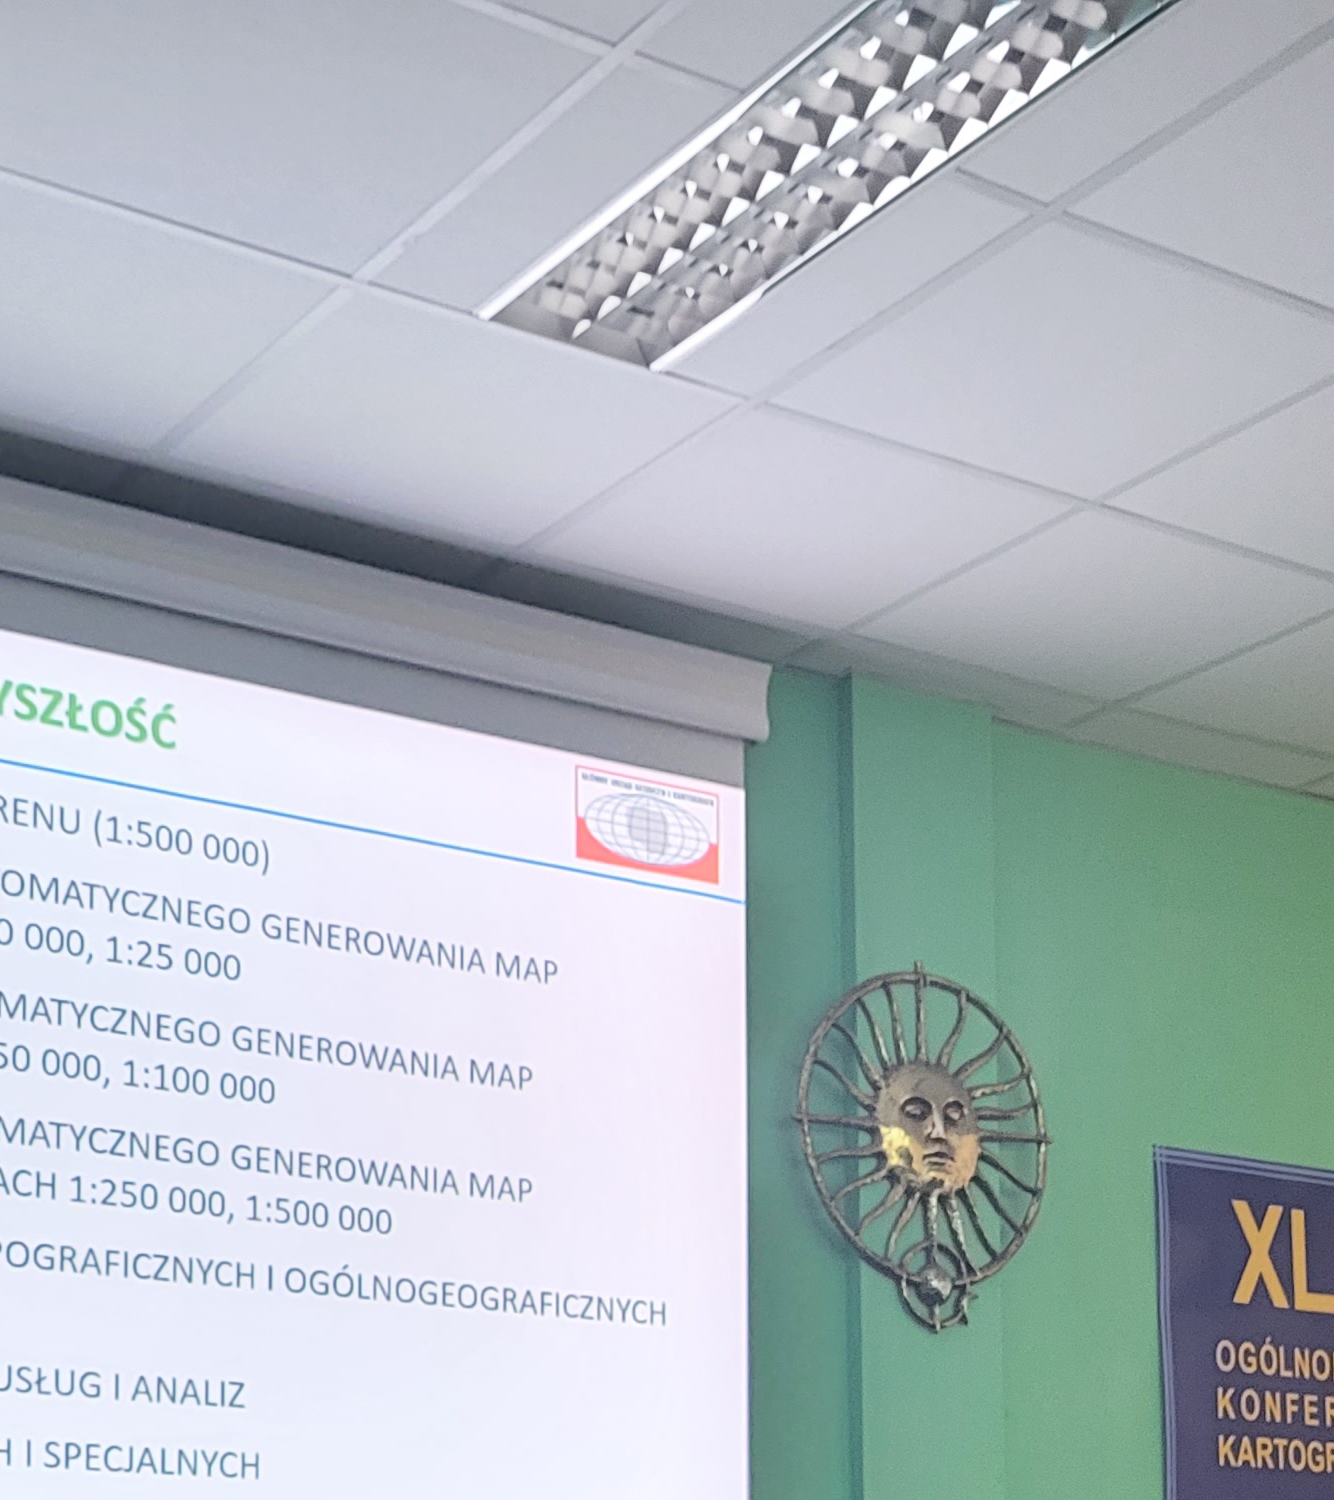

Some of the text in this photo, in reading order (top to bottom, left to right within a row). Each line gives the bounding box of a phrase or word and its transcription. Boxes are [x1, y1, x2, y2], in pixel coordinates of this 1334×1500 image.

[93, 809, 194, 856] (1:500
[202, 833, 270, 877] 000)
[24, 922, 94, 965] 000,
[106, 935, 174, 971] 1:25
[183, 947, 242, 982] 000
[261, 913, 486, 975] GENEROWANIA
[495, 951, 559, 985] MAP
[41, 1047, 111, 1090] 000,
[122, 1059, 210, 1097] 1:100
[219, 1071, 276, 1105] 000
[231, 1024, 460, 1083] GENEROWANIA
[469, 1058, 534, 1091] MAP
[230, 1143, 460, 1196] GENEROWANIA
[469, 1171, 533, 1203] MAP
[70, 1175, 159, 1211] 1:250
[168, 1185, 235, 1225] 000,
[246, 1194, 330, 1229] 1:500
[338, 1204, 393, 1235] 000
[266, 1264, 275, 1292] I
[284, 1263, 667, 1327] OGÓLNOGEOGRAFICZNYCH
[113, 1372, 121, 1401] I
[130, 1374, 246, 1409] ANALIZ
[25, 1438, 33, 1468] I
[43, 1440, 260, 1481] SPECJALNYCH
